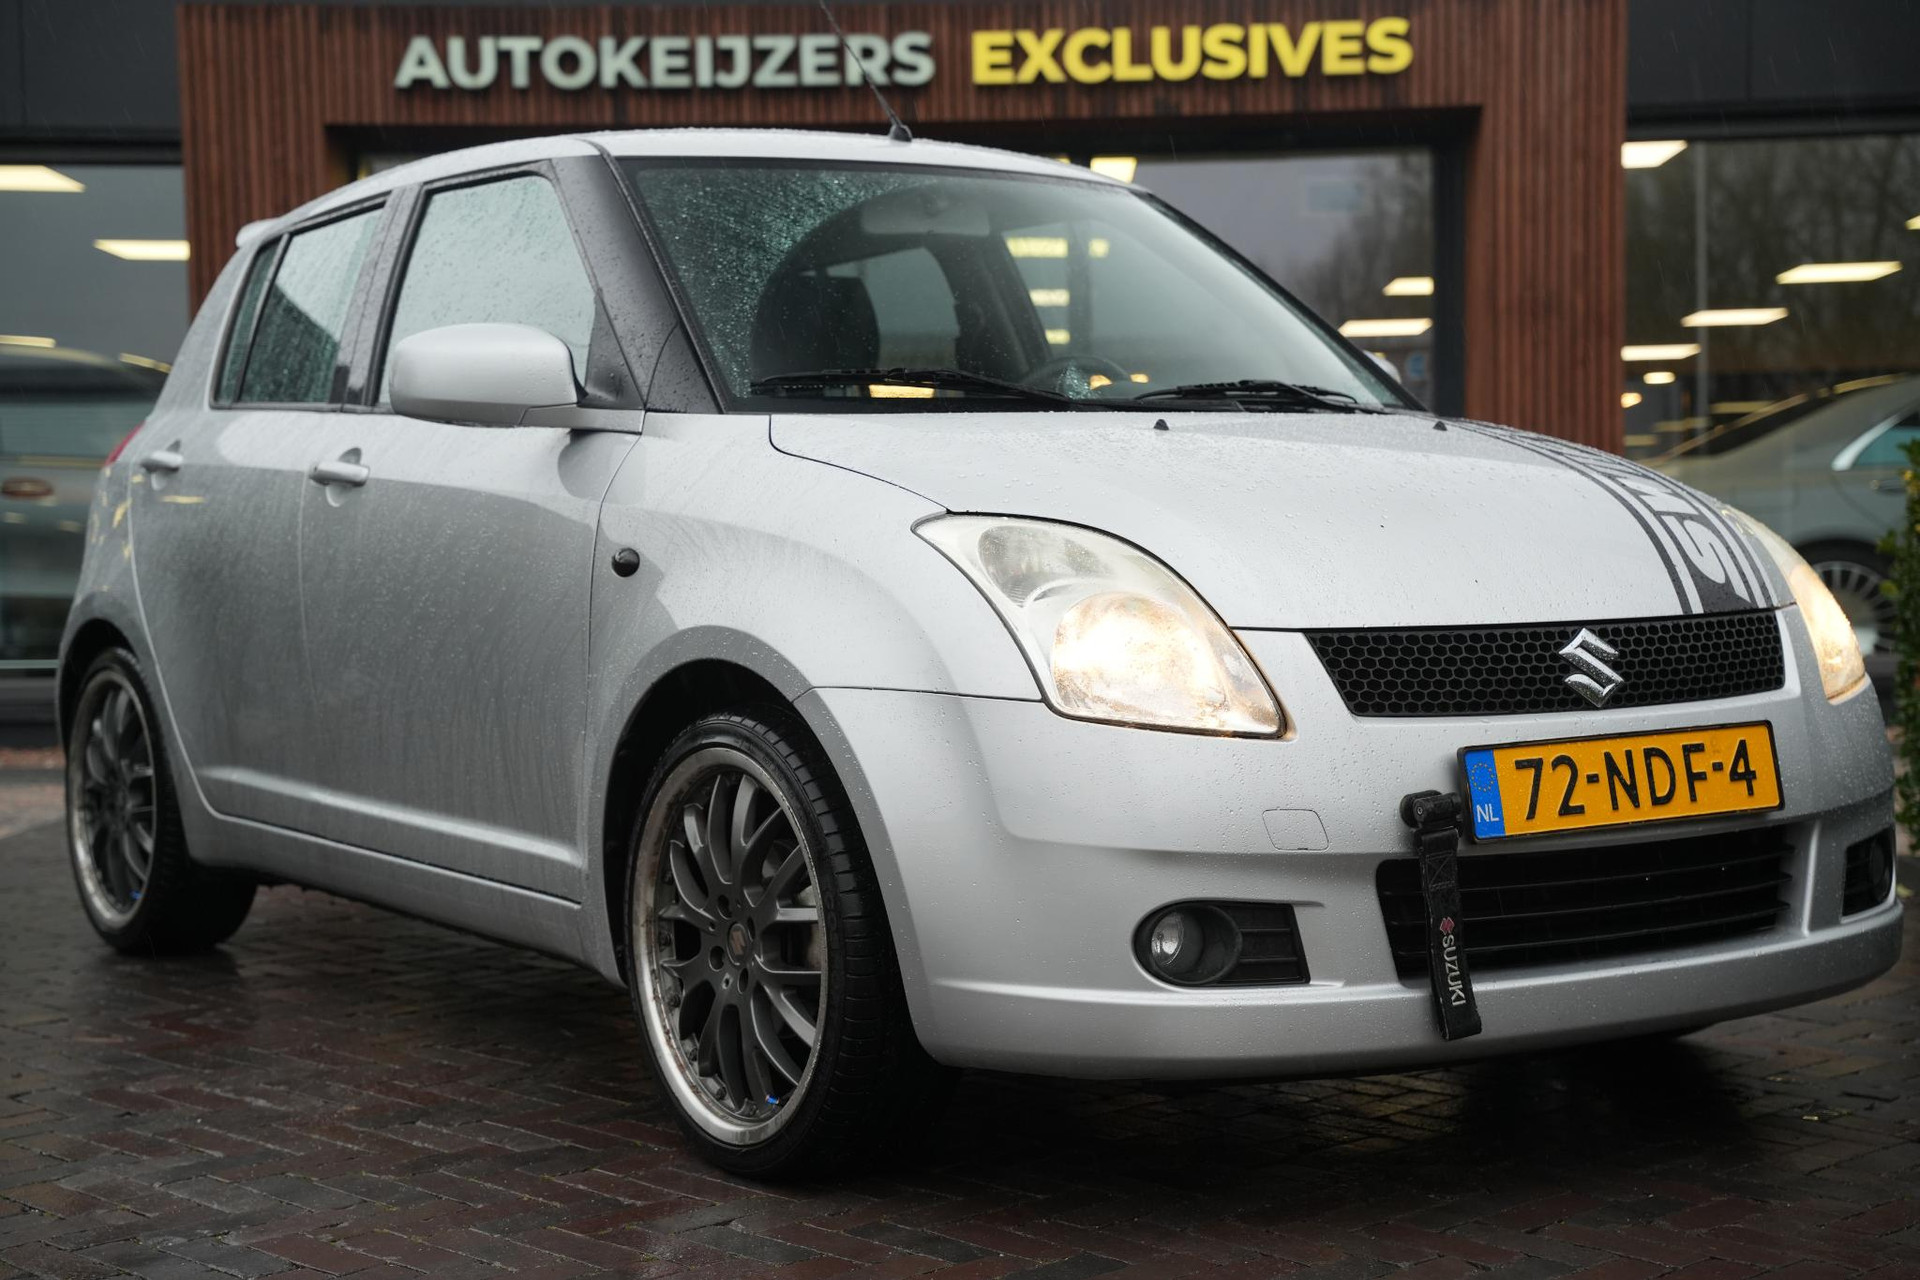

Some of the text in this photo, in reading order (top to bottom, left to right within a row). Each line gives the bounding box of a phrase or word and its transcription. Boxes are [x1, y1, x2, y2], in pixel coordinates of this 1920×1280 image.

[394, 16, 1414, 91] AUTOKEIJZERS EXCLUSIVES
[1476, 803, 1500, 823] NL
[1514, 738, 1757, 820] 72-NDF-4
[1442, 935, 1466, 1006] SUZUKI
